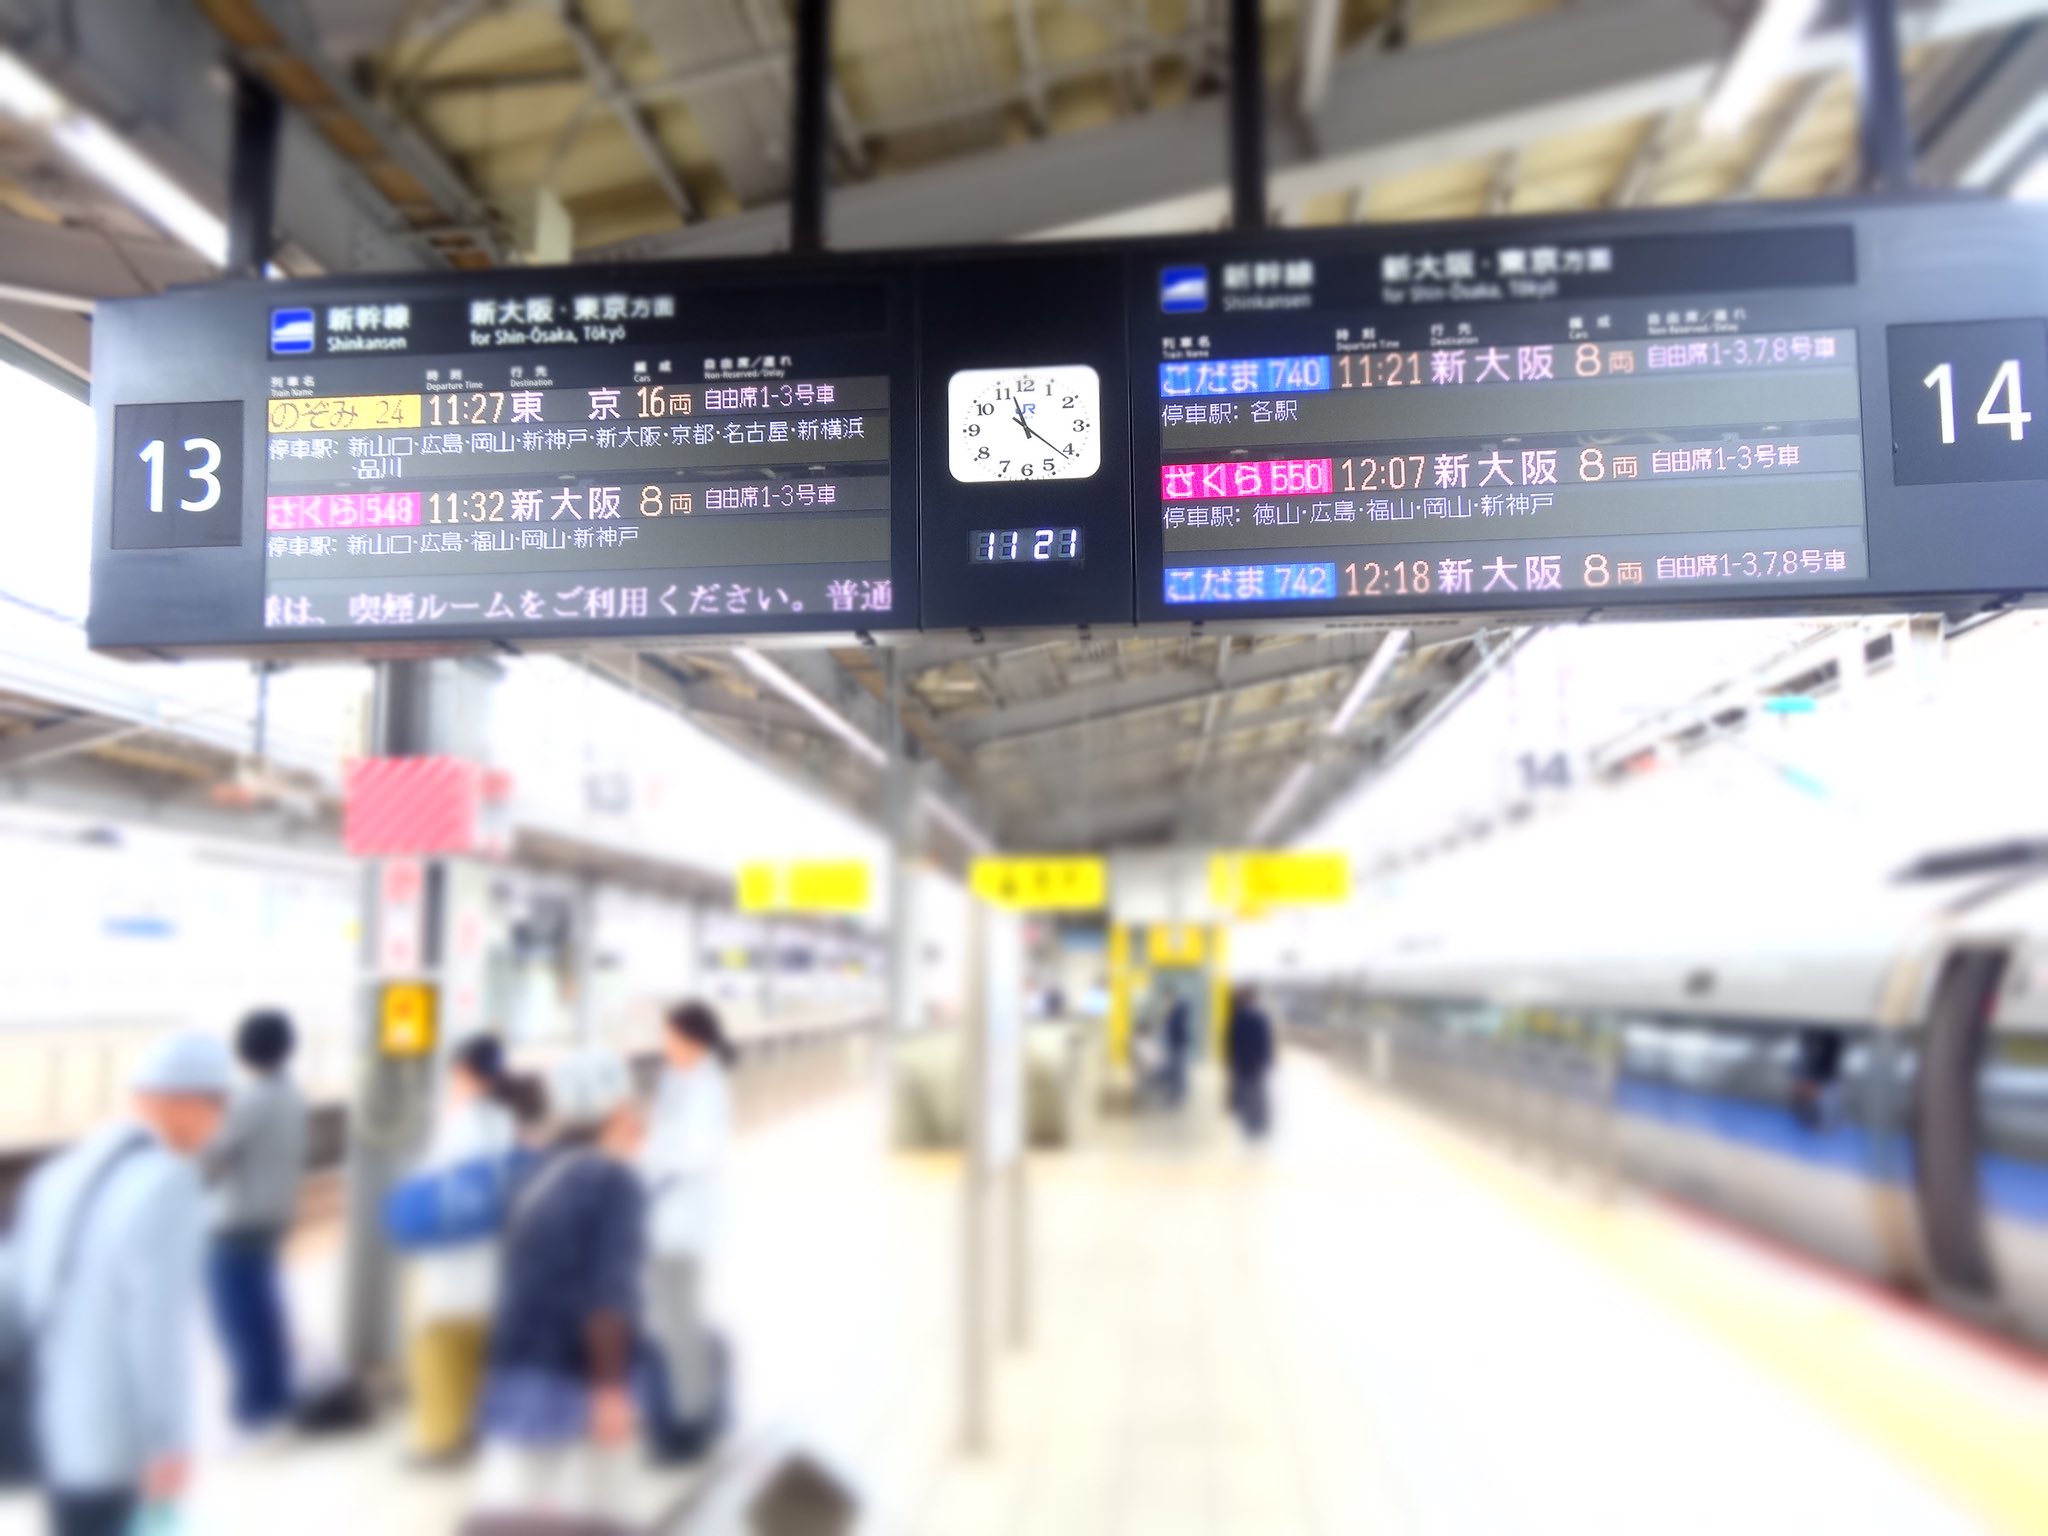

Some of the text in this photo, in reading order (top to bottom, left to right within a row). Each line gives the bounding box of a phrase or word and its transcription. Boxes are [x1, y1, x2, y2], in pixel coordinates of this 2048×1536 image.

[327, 304, 410, 332] 新幹線
[327, 335, 407, 352] Shinkansen
[470, 331, 490, 346] for
[1163, 360, 1320, 394] こだま 740
[1338, 353, 1422, 388] 11:21
[1431, 345, 1554, 385] 新大阪
[426, 380, 483, 392] Departure Time
[510, 378, 553, 388] Destination
[634, 375, 651, 383] Cars
[1016, 379, 1035, 393] 12
[1046, 384, 1053, 396] 1
[291, 388, 314, 398] Name
[705, 383, 835, 410] 自由席1-3号車
[995, 388, 1011, 400] 11
[1062, 396, 1075, 409] 2
[1923, 359, 2032, 444] 14
[271, 399, 403, 430] のぞみ 24
[429, 392, 504, 426] 11:27
[977, 403, 994, 416] 10
[1251, 400, 1297, 424] 各駅
[968, 424, 980, 437] 9
[1073, 419, 1085, 432] 3
[978, 447, 990, 459] 8
[1062, 443, 1075, 456] 4
[1652, 443, 1801, 472] 自由席1-3号車
[139, 438, 221, 512] 13
[999, 460, 1011, 473] 7
[1021, 464, 1033, 476] 6
[1043, 458, 1055, 471] 5
[1341, 455, 1425, 491] 12:07
[1434, 449, 1558, 489] 新大阪
[1164, 464, 1322, 497] さくら 550
[429, 491, 504, 524] 11:32
[511, 487, 621, 522] 新大阪
[705, 483, 836, 509] 自由席1-3号車
[269, 497, 413, 528] さくら 548
[1167, 566, 1326, 601] こだま 742
[1345, 560, 1430, 596] 12:18
[1438, 556, 1563, 592] 新大阪
[349, 583, 804, 624] 喫煙ルームをご利用ください。
[826, 579, 893, 613] 普通
[1515, 750, 1572, 793] 14
